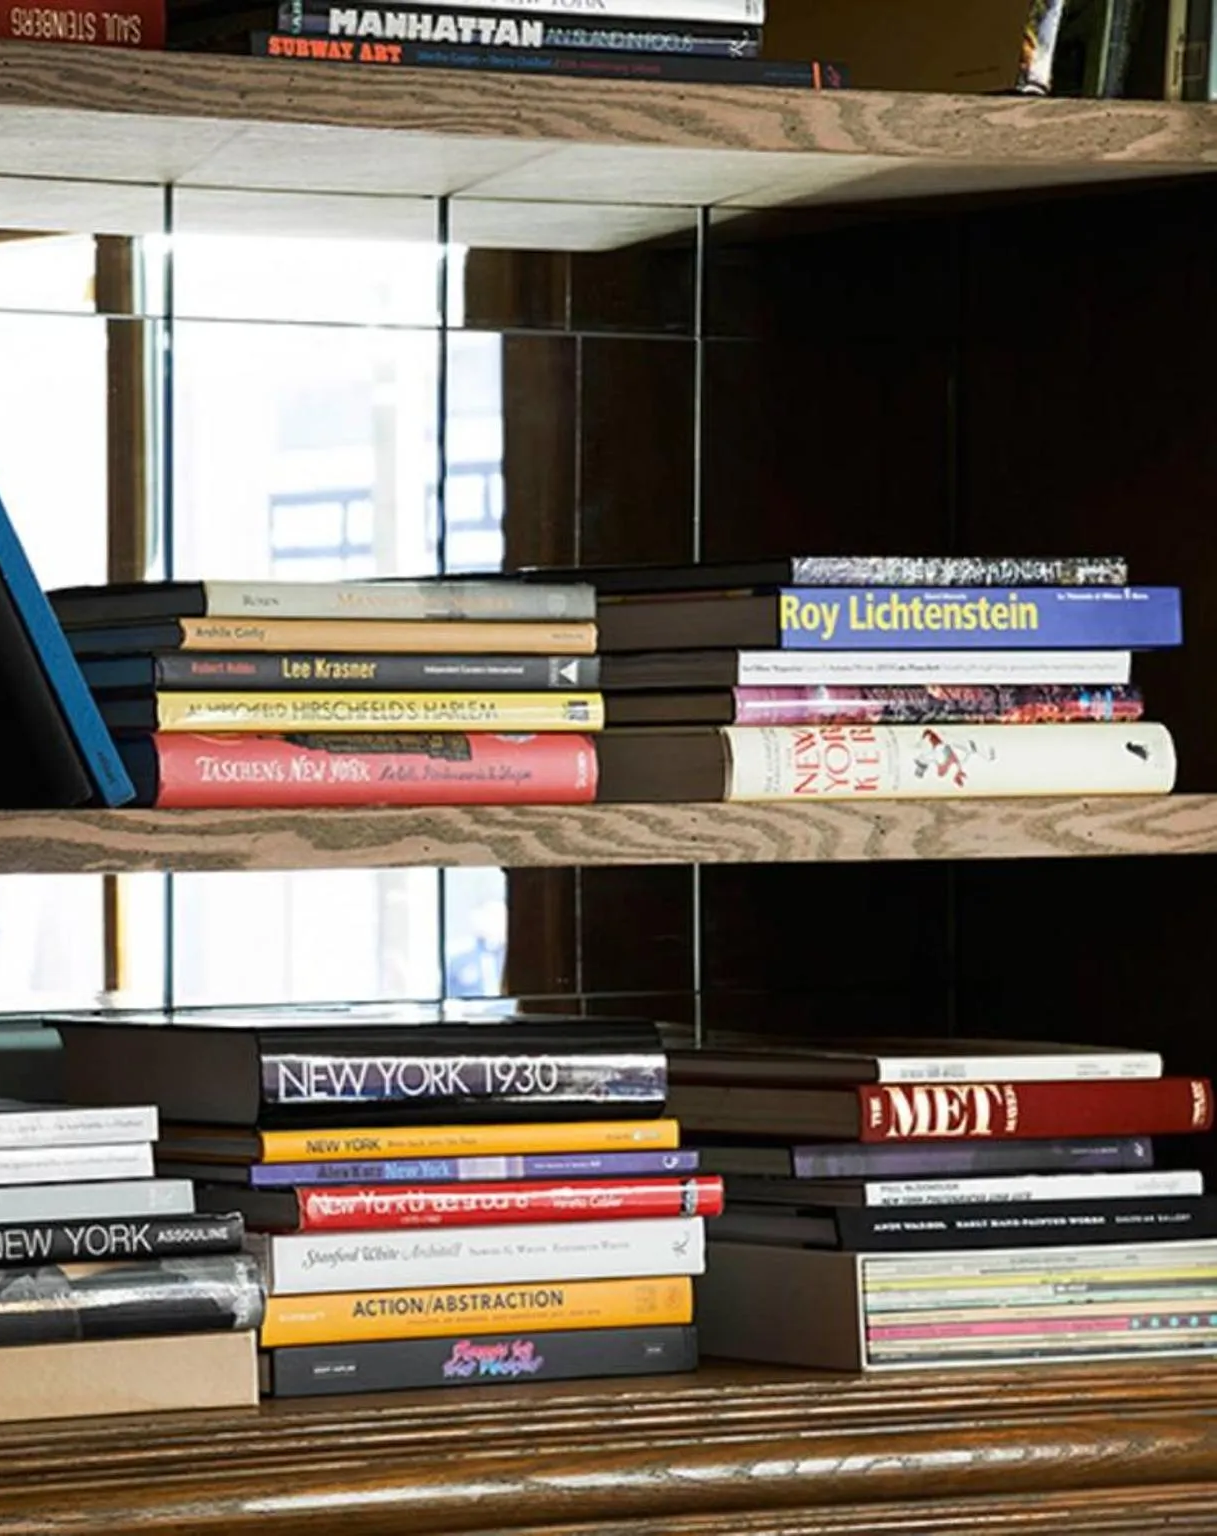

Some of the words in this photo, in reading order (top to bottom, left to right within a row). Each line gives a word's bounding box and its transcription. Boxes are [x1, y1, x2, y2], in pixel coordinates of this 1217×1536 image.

[10, 7, 96, 41] STEINBERG
[102, 12, 142, 43] SAUL
[329, 8, 544, 48] MANHATTAN
[268, 36, 355, 61] SUBWAY
[359, 42, 402, 63] ART
[779, 593, 841, 640] Roy
[849, 591, 1039, 631] Lichtenstein
[282, 657, 312, 680] Lee
[313, 657, 379, 680] Krasner
[794, 728, 820, 794] NEW
[278, 1060, 370, 1098] NEW
[375, 1059, 471, 1097] YORK
[484, 1058, 560, 1094] 1930
[883, 1084, 1003, 1138] MET
[305, 1139, 341, 1154] NEW
[343, 1137, 382, 1152] YORK
[384, 1162, 416, 1178] New
[417, 1161, 450, 1177] York
[63, 1223, 153, 1256] YORK
[157, 1225, 229, 1243] ASSOULINE
[352, 1289, 564, 1319] ACTION/ABSTRACTION
